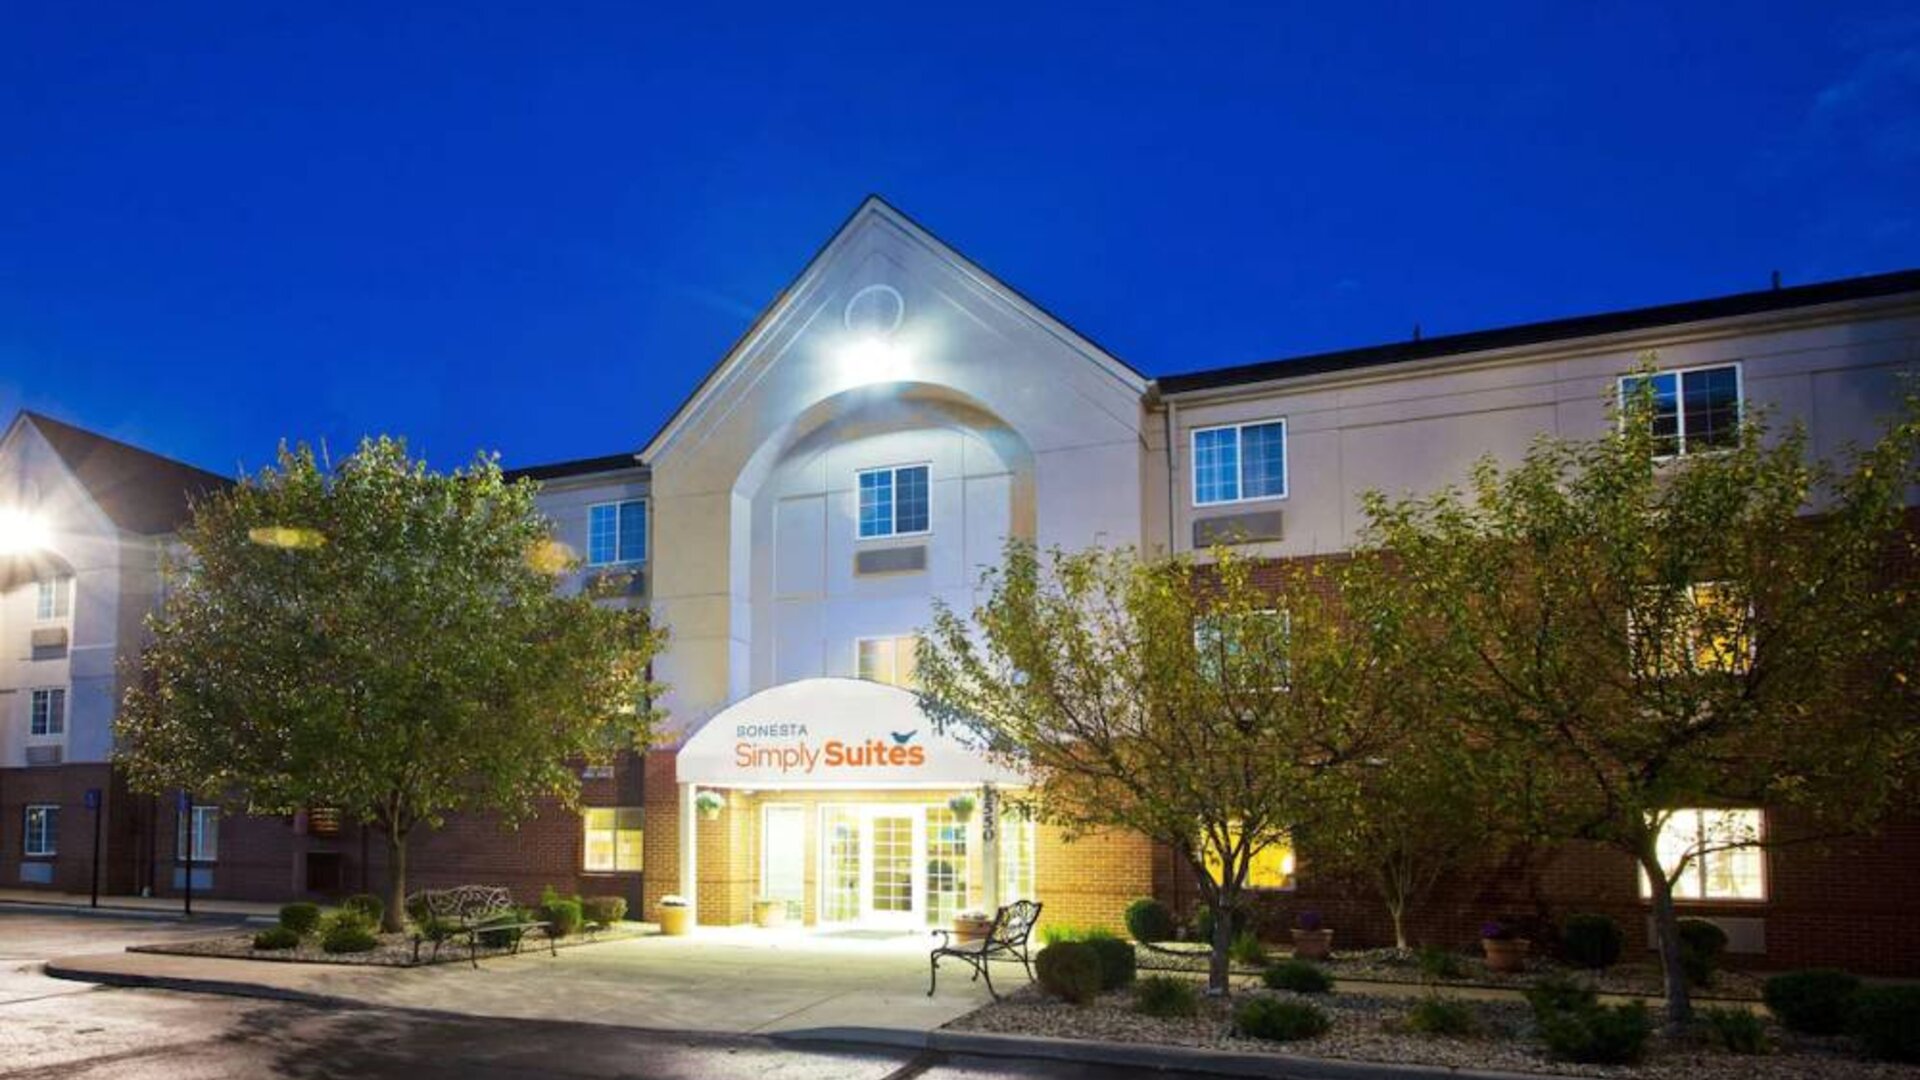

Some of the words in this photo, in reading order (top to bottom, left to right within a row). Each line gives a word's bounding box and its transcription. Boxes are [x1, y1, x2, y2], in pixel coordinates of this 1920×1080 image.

[736, 723, 808, 738] SONESTA
[735, 742, 820, 774] Simply
[824, 739, 925, 767] Suites
